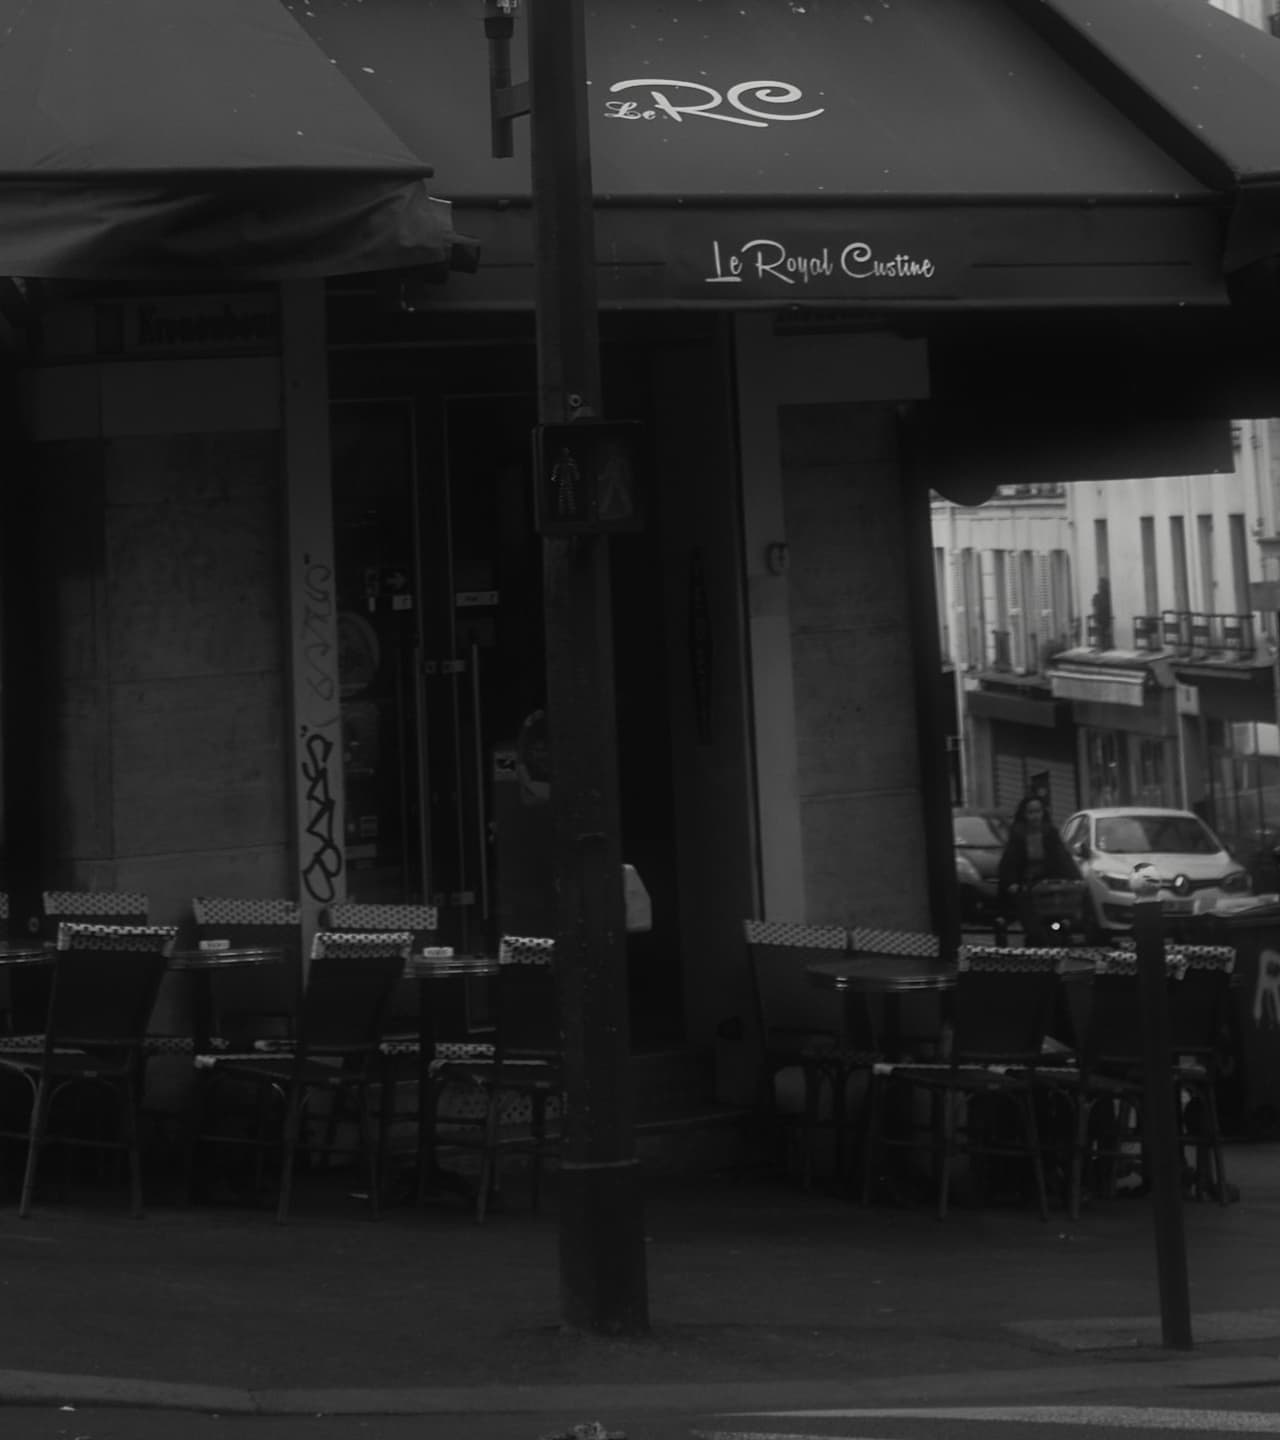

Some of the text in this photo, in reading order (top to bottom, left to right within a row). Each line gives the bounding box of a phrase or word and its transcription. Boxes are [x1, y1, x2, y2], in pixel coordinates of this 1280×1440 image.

[604, 78, 825, 128] Le RC
[704, 239, 936, 284] Le Royal Custine
